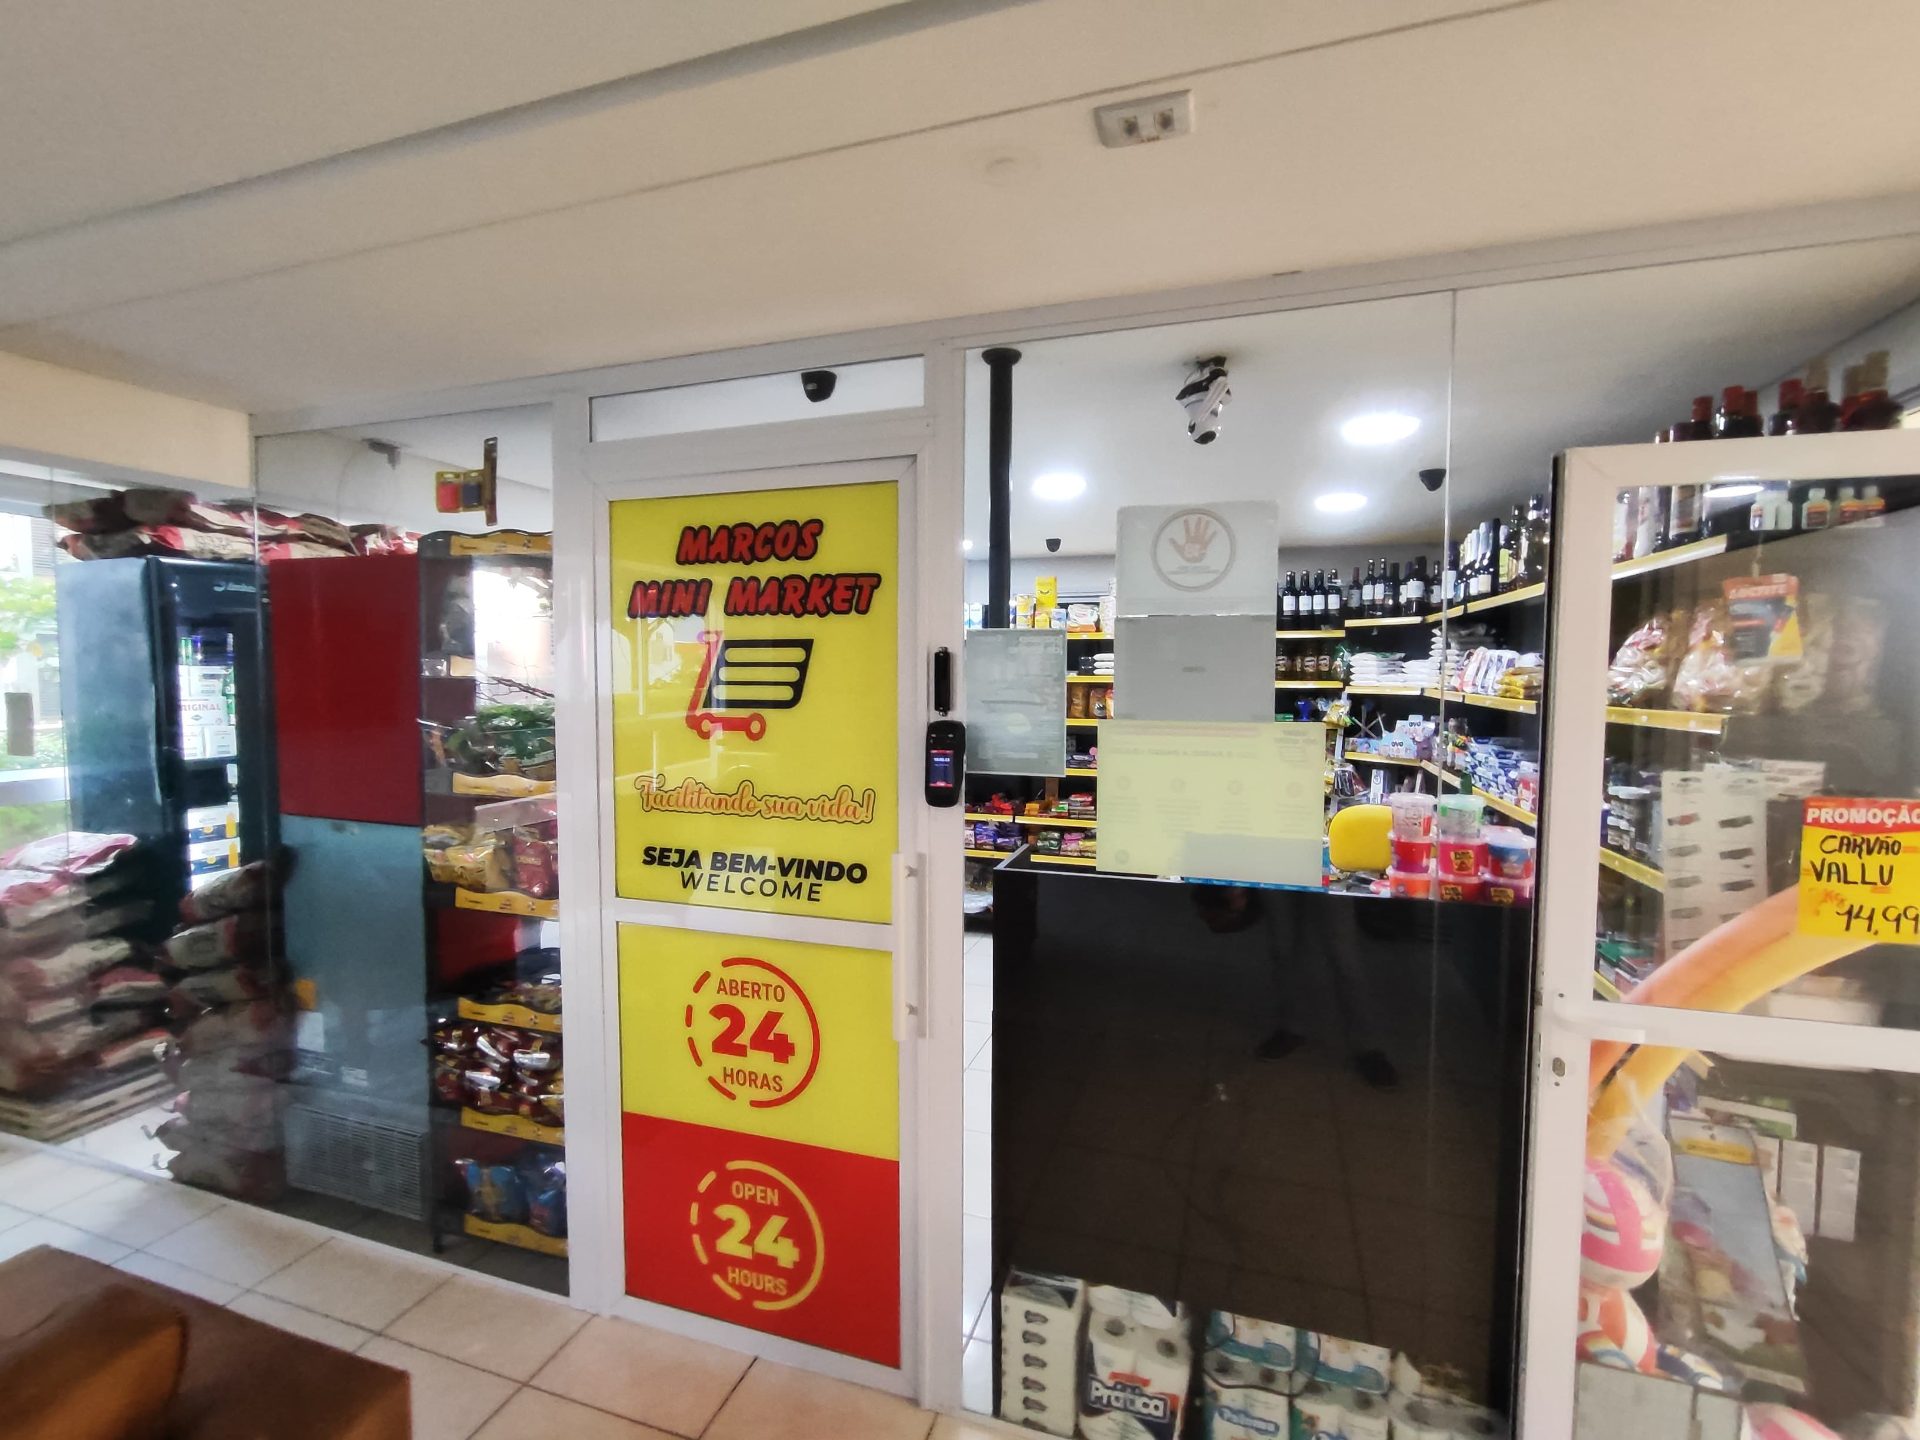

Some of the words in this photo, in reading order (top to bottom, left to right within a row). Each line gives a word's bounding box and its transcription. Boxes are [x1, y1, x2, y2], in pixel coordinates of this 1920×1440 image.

[676, 519, 823, 565] MARCOS
[627, 578, 712, 618] MINI
[724, 573, 881, 618] MARKET
[634, 774, 759, 817] Facilitando
[760, 795, 803, 822] sua
[804, 785, 876, 824] vida!
[642, 846, 702, 869] SEJA
[710, 852, 868, 884] BEM-VINDO
[1809, 858, 1894, 886] VALLU
[680, 871, 823, 902] WELCOME
[716, 977, 785, 1002] ABERTO
[709, 1003, 795, 1064] 24
[723, 1066, 783, 1092] HORAS
[731, 1181, 779, 1206] OPEN
[713, 1204, 800, 1269] 24
[727, 1266, 787, 1296] HOURS
